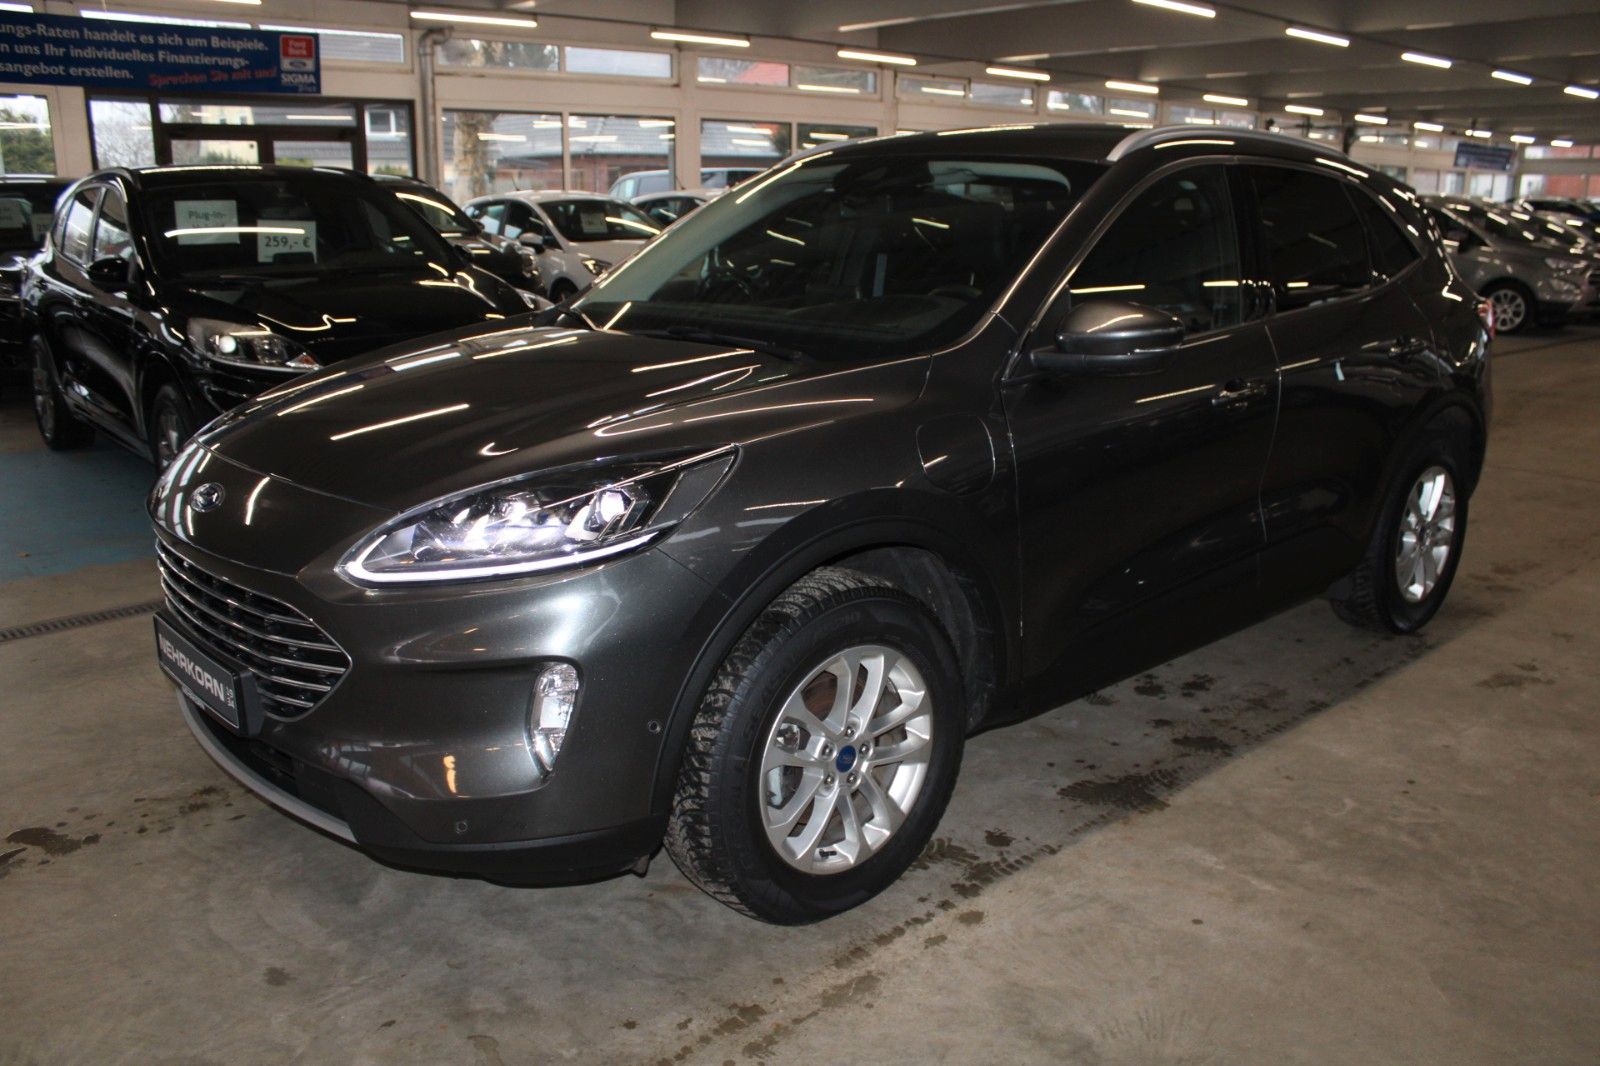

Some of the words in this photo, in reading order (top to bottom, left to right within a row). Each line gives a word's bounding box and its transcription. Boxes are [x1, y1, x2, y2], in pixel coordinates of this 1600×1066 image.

[83, 28, 136, 44] handelt
[140, 34, 155, 45] es
[158, 32, 183, 46] sich
[186, 37, 208, 48] um
[211, 36, 269, 52] Beispiele.
[14, 43, 41, 56] uns
[45, 42, 65, 57] Ihr
[70, 44, 155, 63] individuelles
[158, 50, 250, 69] Finanzierungs-
[69, 65, 134, 80] erstellen.
[264, 236, 299, 249] 259,-
[302, 237, 311, 249] €
